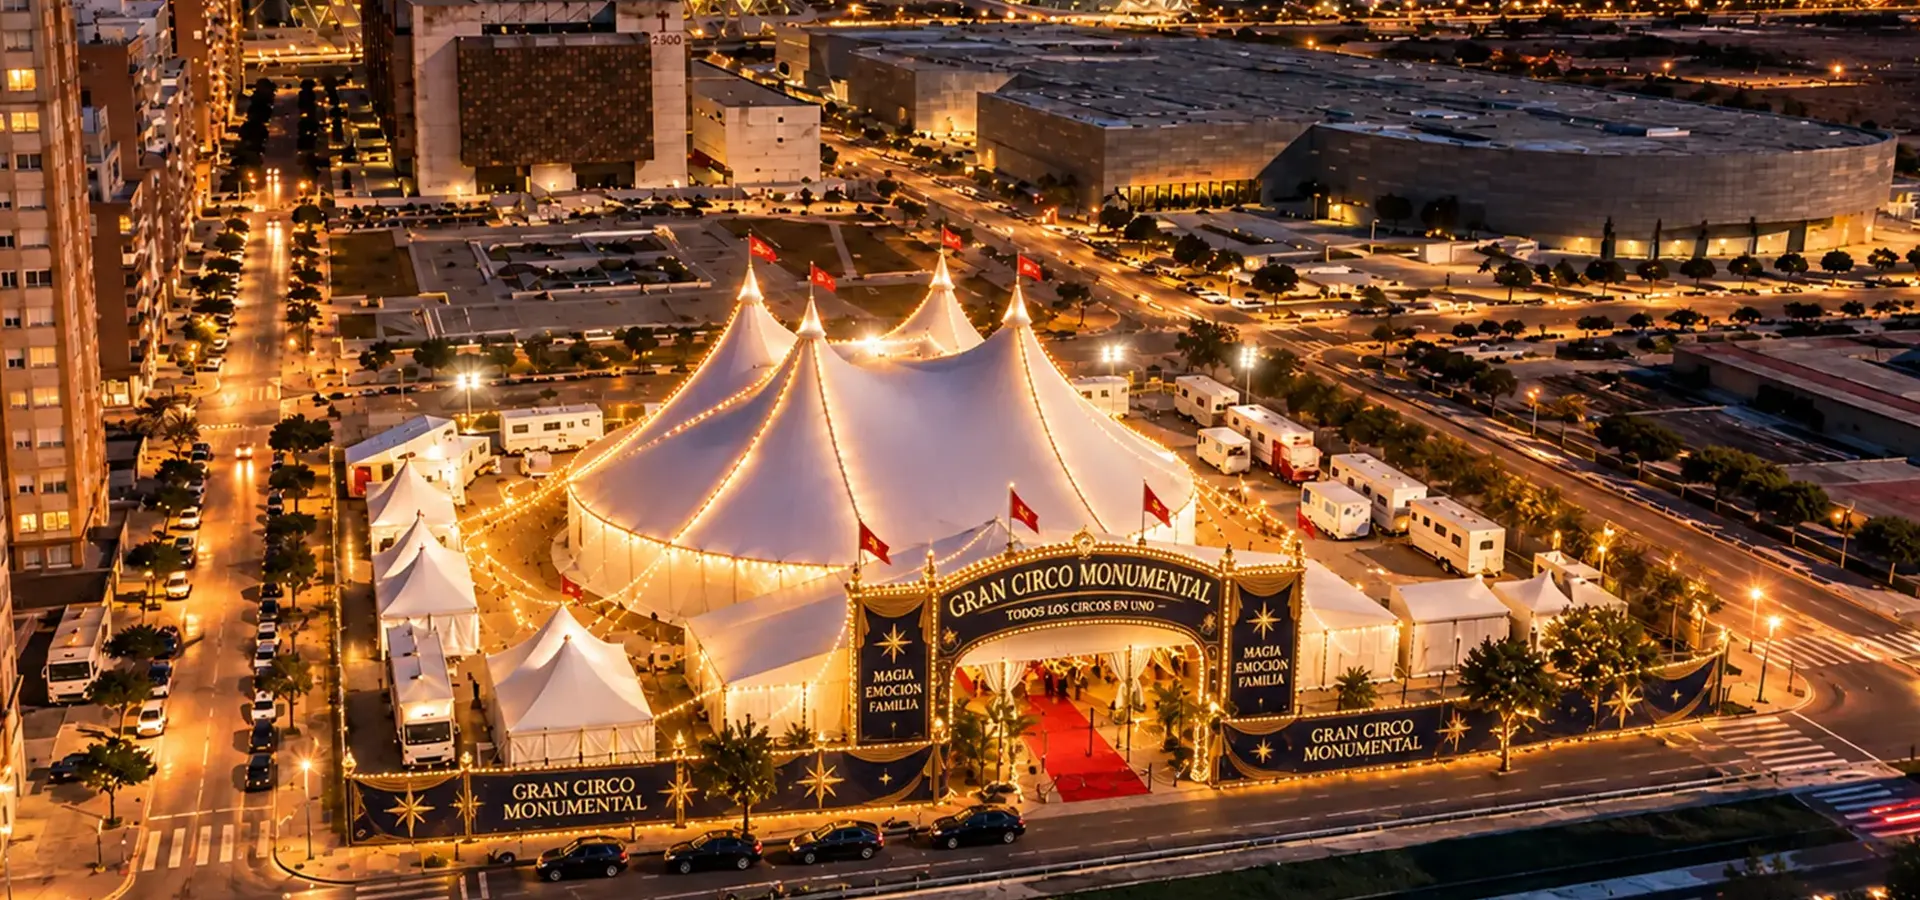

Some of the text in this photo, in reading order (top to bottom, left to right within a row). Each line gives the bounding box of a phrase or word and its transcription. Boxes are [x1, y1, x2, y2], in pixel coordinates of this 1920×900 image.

[949, 563, 1211, 618] GRAN CIRCO MONUMENTAL
[1005, 600, 1155, 621] TODOS LOS CIRCOS EN UNO
[1243, 645, 1282, 659] MAGIA
[873, 668, 915, 683] MAGIA
[1238, 673, 1285, 688] FAMILIA
[869, 698, 919, 713] FAMILIA
[1311, 719, 1414, 744] GRAN CIRCO
[1303, 736, 1423, 762] MONUMENTAL
[512, 776, 636, 800] GRAN CIRCO
[503, 795, 648, 821] MONUMENTAL
